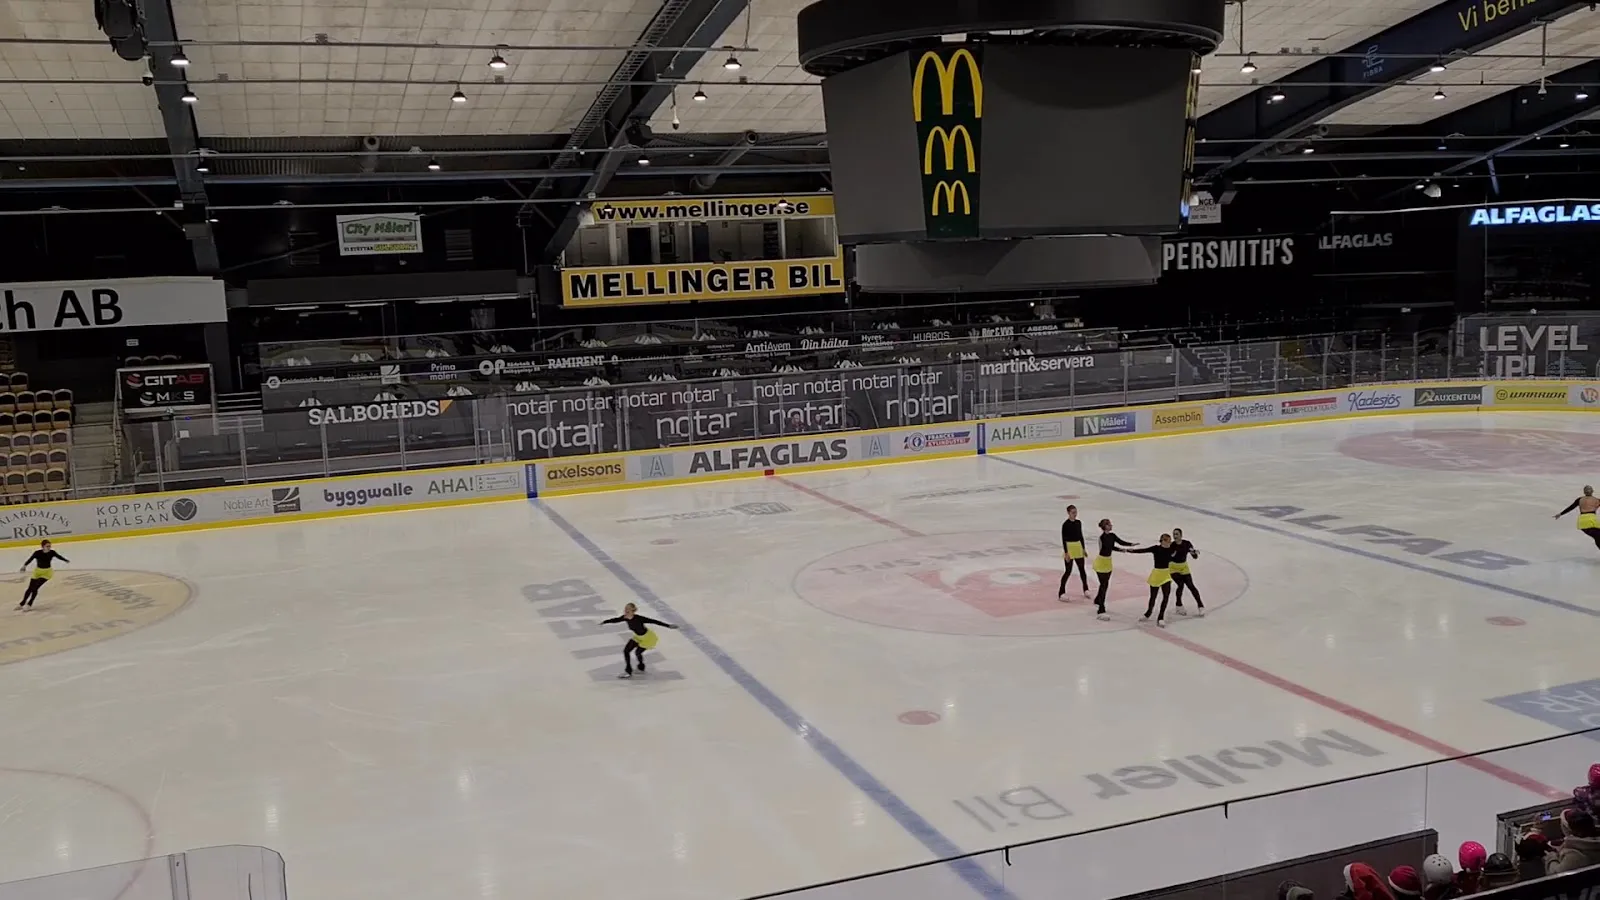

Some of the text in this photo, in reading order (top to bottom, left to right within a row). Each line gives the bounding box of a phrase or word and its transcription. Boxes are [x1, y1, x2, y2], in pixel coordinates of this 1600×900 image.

[1458, 5, 1478, 31] Vi
[345, 221, 413, 236] City Måleri
[570, 264, 842, 299] MELLINGER BIL
[54, 288, 123, 328] AB
[800, 338, 819, 351] Din
[820, 337, 849, 350] hälsa
[1480, 325, 1588, 351] LEVEL
[430, 363, 456, 372] Prima
[547, 355, 605, 370] RAMIRENT
[980, 355, 1094, 376] martin&servera
[144, 374, 205, 386] GITAB
[753, 380, 799, 398] notar
[803, 377, 848, 395] notar
[852, 374, 897, 391] notar
[900, 371, 943, 388] notar
[506, 388, 719, 416] notar notar notar notar
[886, 391, 959, 420] notar
[1434, 393, 1481, 402] AUXENTUM
[308, 400, 440, 426] SALBOHEDS
[769, 402, 845, 427] notar
[1155, 411, 1201, 425] Assemblin
[656, 409, 738, 440] notar
[991, 426, 1027, 442] AHA!
[517, 421, 605, 451] notar
[689, 439, 848, 474] ALFAGLAS
[547, 462, 622, 481] axelssons
[323, 483, 413, 507] byggwalle
[427, 475, 475, 495] AHA!
[96, 500, 166, 516] KOPPAR
[223, 499, 252, 511] Noble
[98, 512, 169, 529] HÄLSAN
[13, 523, 50, 539] RÖR
